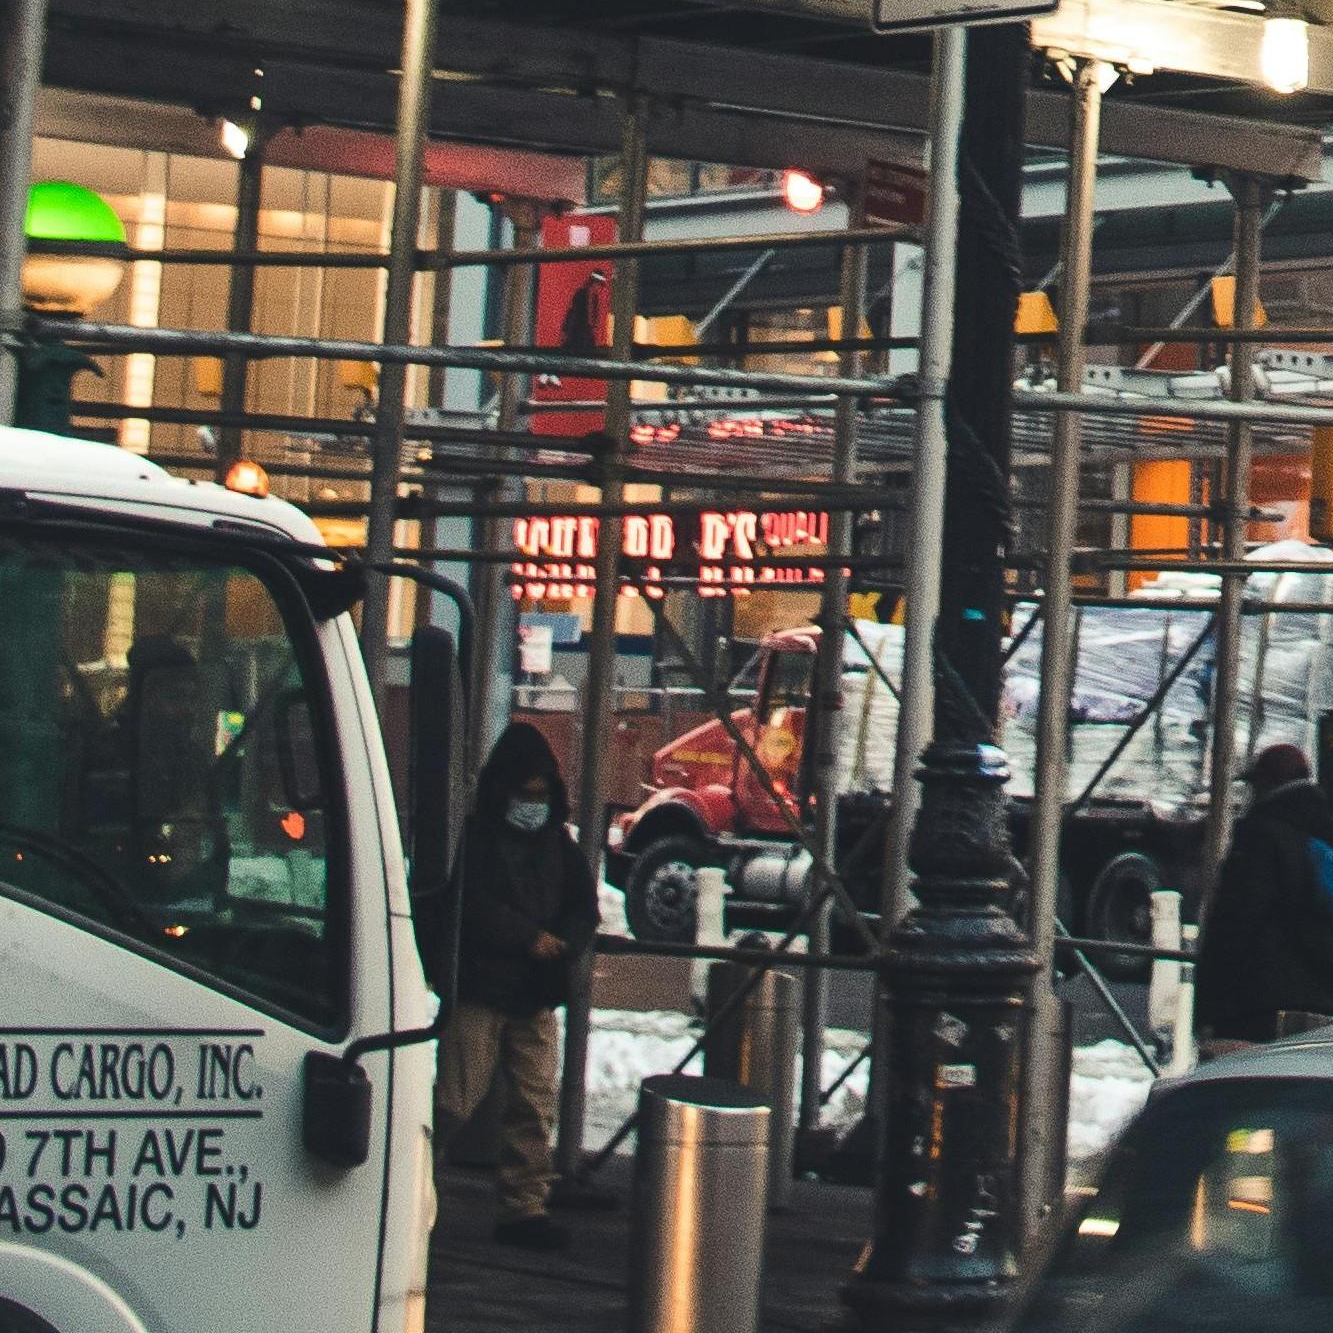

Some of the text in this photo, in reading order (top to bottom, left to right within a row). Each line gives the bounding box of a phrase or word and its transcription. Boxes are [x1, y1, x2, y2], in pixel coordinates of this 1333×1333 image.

[50, 1042, 184, 1106] CARGO,
[196, 1043, 264, 1100] INC.
[25, 1128, 118, 1178] 7TH
[132, 1128, 250, 1184] AVE.,
[0, 1182, 265, 1239] ASSAIC, NJ
